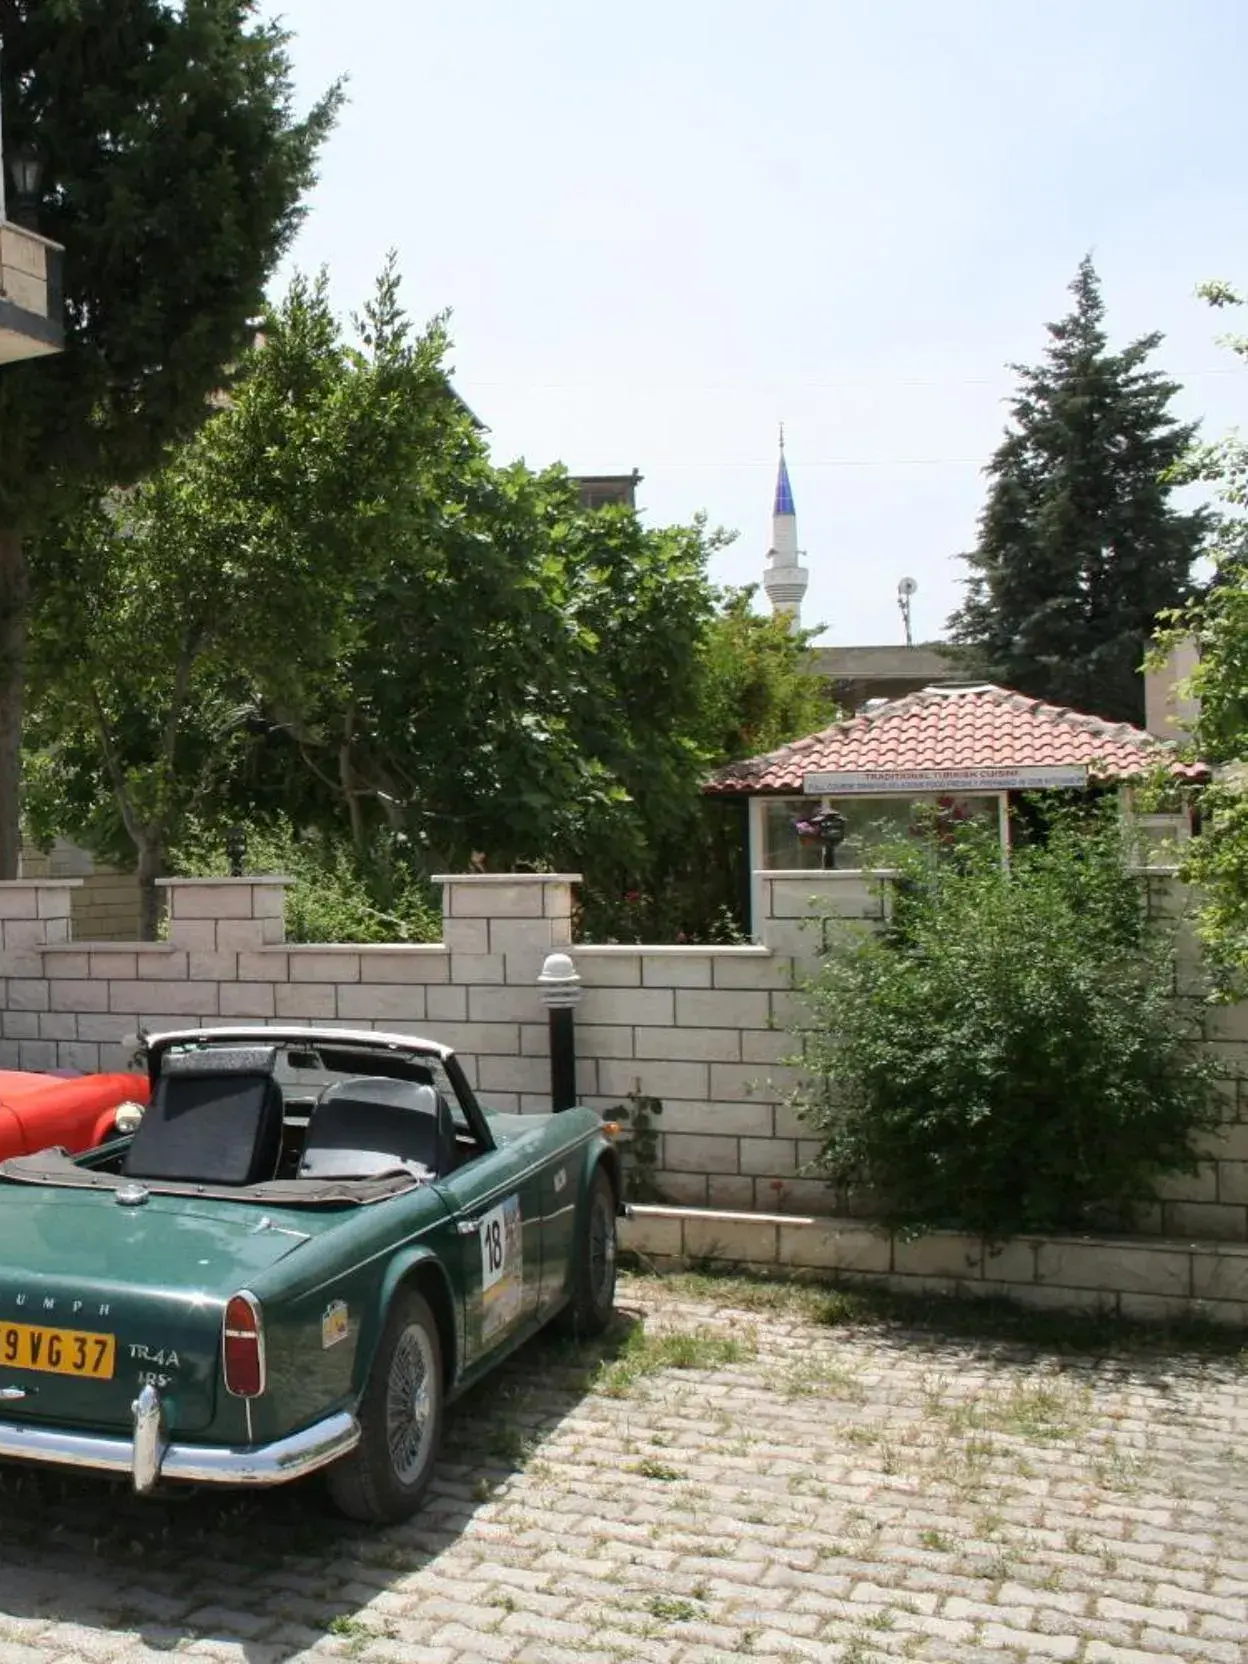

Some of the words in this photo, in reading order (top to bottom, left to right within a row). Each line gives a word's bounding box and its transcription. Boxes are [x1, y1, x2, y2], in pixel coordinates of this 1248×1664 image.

[865, 772, 930, 781] TRADITIONAL
[979, 769, 1018, 778] CUISINE
[485, 1220, 502, 1273] 18
[30, 1331, 63, 1367] VG
[72, 1337, 108, 1372] 37
